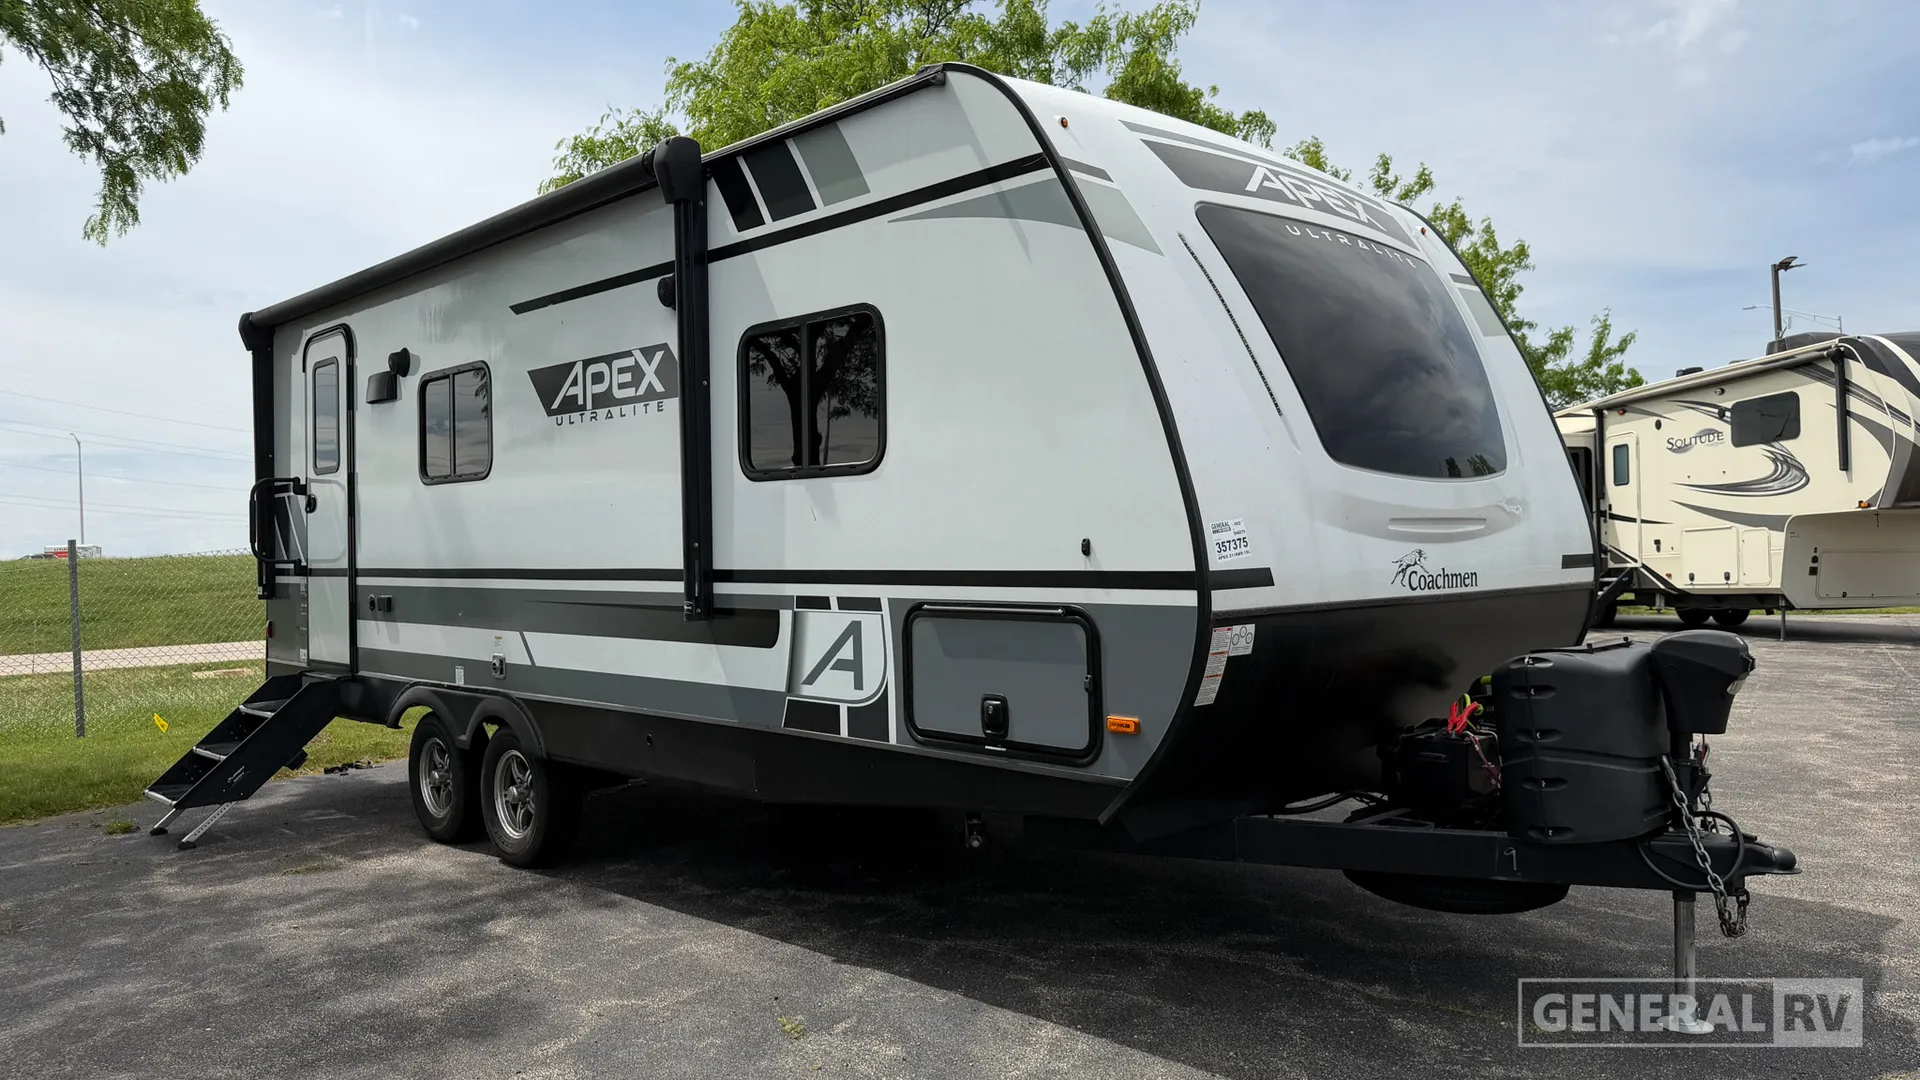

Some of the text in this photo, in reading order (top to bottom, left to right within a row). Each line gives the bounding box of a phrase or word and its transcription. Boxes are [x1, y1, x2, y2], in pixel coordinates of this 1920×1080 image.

[1245, 165, 1387, 232] APEX
[1285, 224, 1416, 268] ULTRALITE
[551, 349, 666, 411] APEX
[555, 401, 664, 427] ULTRALITE
[1215, 536, 1249, 554] 357375
[1408, 567, 1478, 591] Coachmen
[801, 620, 864, 691] A
